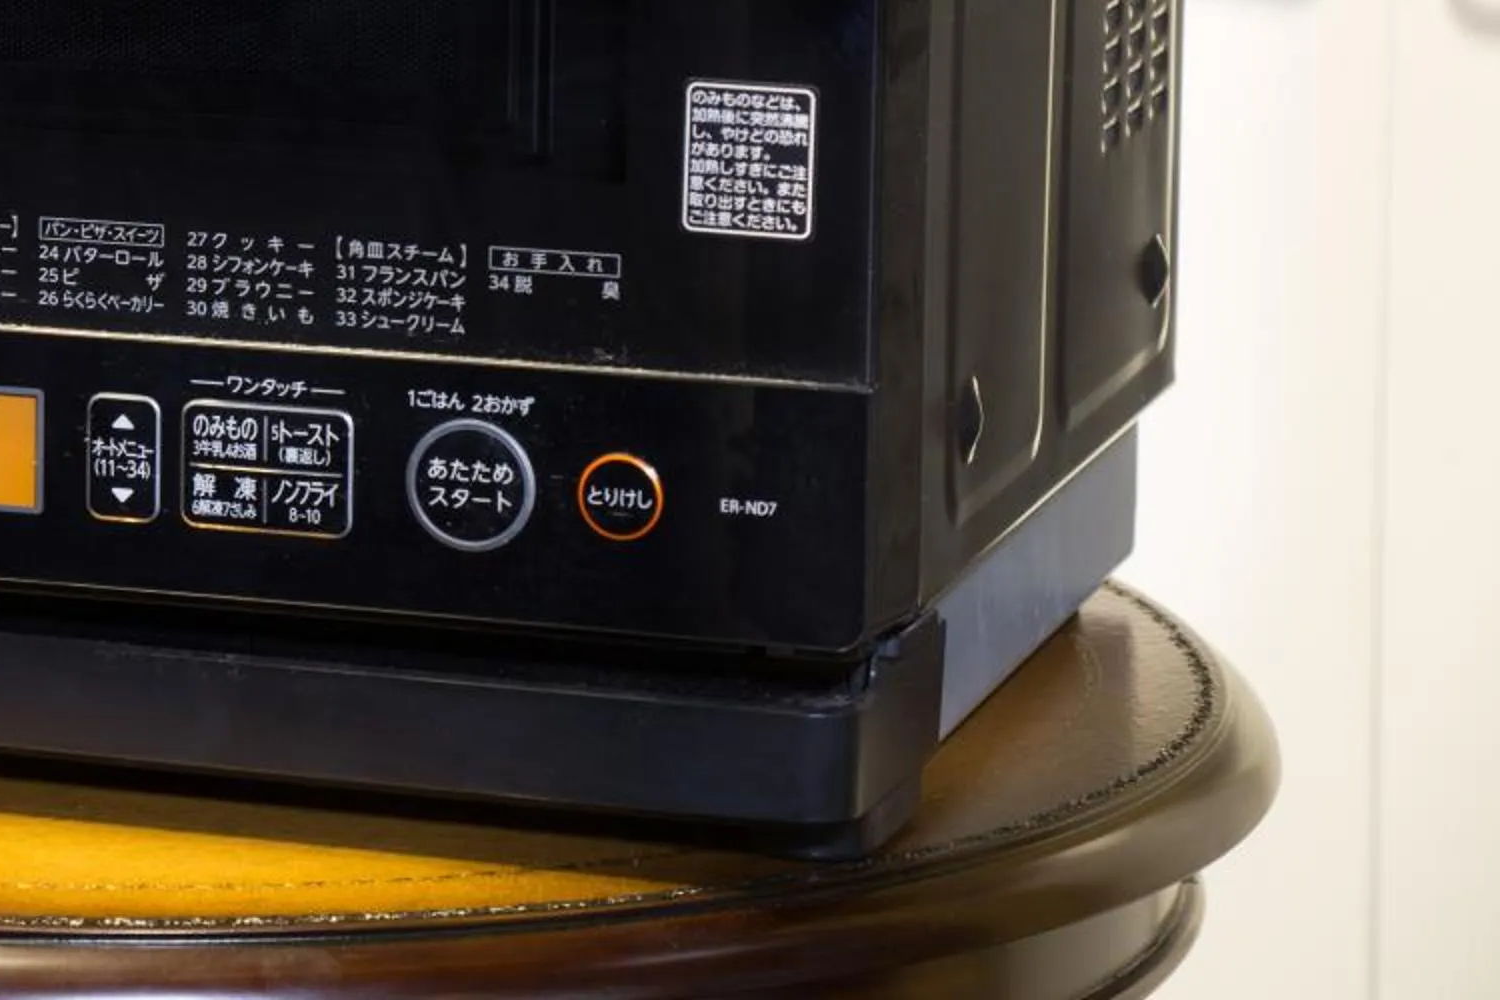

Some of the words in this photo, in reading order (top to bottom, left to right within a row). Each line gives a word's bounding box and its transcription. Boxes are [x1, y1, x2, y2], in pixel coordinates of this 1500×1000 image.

[187, 231, 208, 247] 27
[212, 232, 315, 253] クッキー
[39, 244, 59, 260] 24
[63, 246, 164, 268] バターロール
[187, 254, 208, 270] 28
[211, 254, 315, 279] シフォンケーキ
[501, 252, 604, 273] お手入れ
[39, 267, 59, 283] 25
[336, 264, 355, 280] 31
[361, 265, 467, 290] フランスパン
[488, 275, 510, 291] 34
[187, 277, 207, 293] 29
[211, 277, 315, 299] ブラウニー
[336, 287, 357, 303] 32
[361, 287, 466, 313] スポンジケーキ
[38, 290, 59, 306] 26
[63, 289, 165, 313] らくらくベーカリー
[186, 300, 207, 316] 30
[211, 300, 315, 325] 焼きいも
[335, 310, 357, 327] 33
[361, 310, 466, 335] シュークリーム
[226, 375, 308, 399] ワンタッチ
[407, 389, 465, 411] 1ごはん
[471, 394, 536, 417] 2おかず
[193, 413, 259, 441] のみもの
[91, 436, 155, 460] オートメニュー
[427, 457, 514, 485] あたため
[271, 479, 340, 508] ノンフライ
[428, 486, 513, 513] スタート
[587, 487, 653, 511] とりけし
[720, 497, 778, 517] ER-ND7
